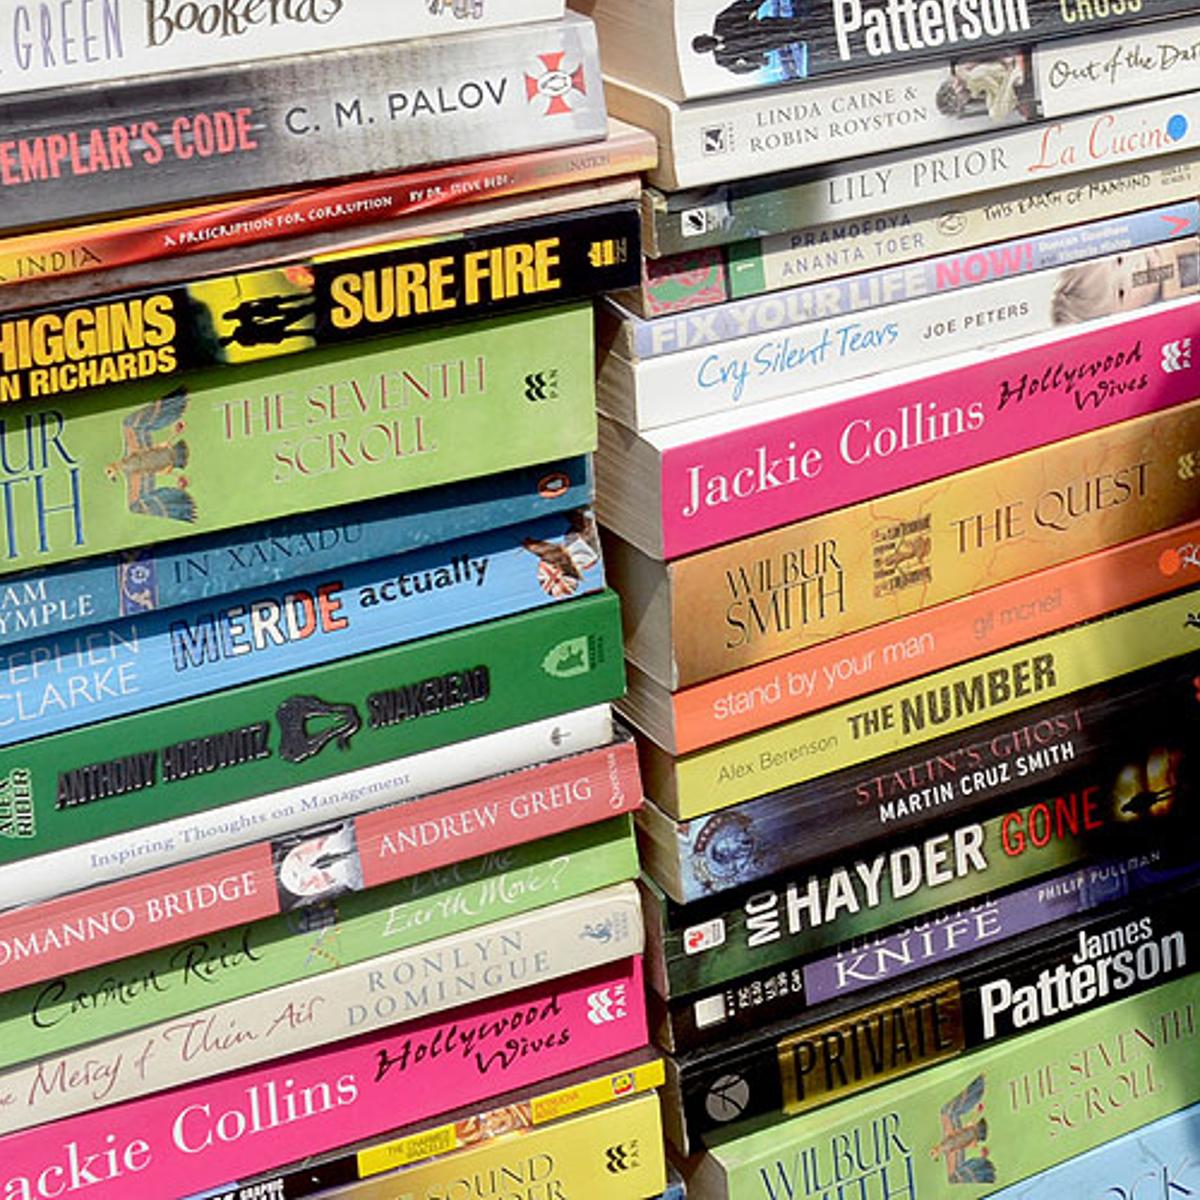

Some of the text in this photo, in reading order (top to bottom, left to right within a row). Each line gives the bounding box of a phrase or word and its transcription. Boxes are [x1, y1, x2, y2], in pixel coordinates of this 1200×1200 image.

[388, 78, 507, 120] PALOV
[829, 107, 927, 138] ROYSTON
[831, 87, 896, 115] CAINE
[172, 108, 257, 160] CODE
[913, 146, 1009, 187] PRIOR
[179, 196, 393, 245] PRESCRIPTION CORRUPTION
[876, 232, 925, 256] TOER
[330, 255, 457, 329] SURE
[464, 237, 562, 306] FIRE
[934, 241, 1034, 289] NOW!
[836, 323, 899, 357] Tears
[963, 302, 1029, 330] PETERS
[30, 345, 177, 397] RICHARDS
[1000, 340, 1142, 406] Hollywood
[274, 416, 437, 482] SCROLL
[840, 400, 985, 466] Collins
[682, 441, 822, 517] Jackie
[1034, 461, 1152, 531] QUEST
[226, 521, 364, 573] XANADU
[359, 554, 489, 609] actually
[726, 570, 844, 648] SMITH
[168, 580, 348, 672] MERDE
[822, 630, 936, 684] your man
[900, 652, 1056, 736] NUMBER
[161, 721, 272, 783] HOROWITZ
[991, 710, 1083, 762] GHOST
[960, 740, 1076, 796] CRUZ SMITH
[510, 777, 592, 820] GREIG
[90, 813, 267, 869] Inspiring Thoughts
[147, 870, 258, 924] BRIDGE
[787, 822, 989, 935] HAYDER
[170, 927, 268, 985] Reid
[367, 930, 525, 993] RONLYN
[833, 909, 1003, 990] KNIFE
[980, 930, 1187, 1041] Patterson
[790, 999, 954, 1103] PRIVATE
[172, 1071, 359, 1154] Collins
